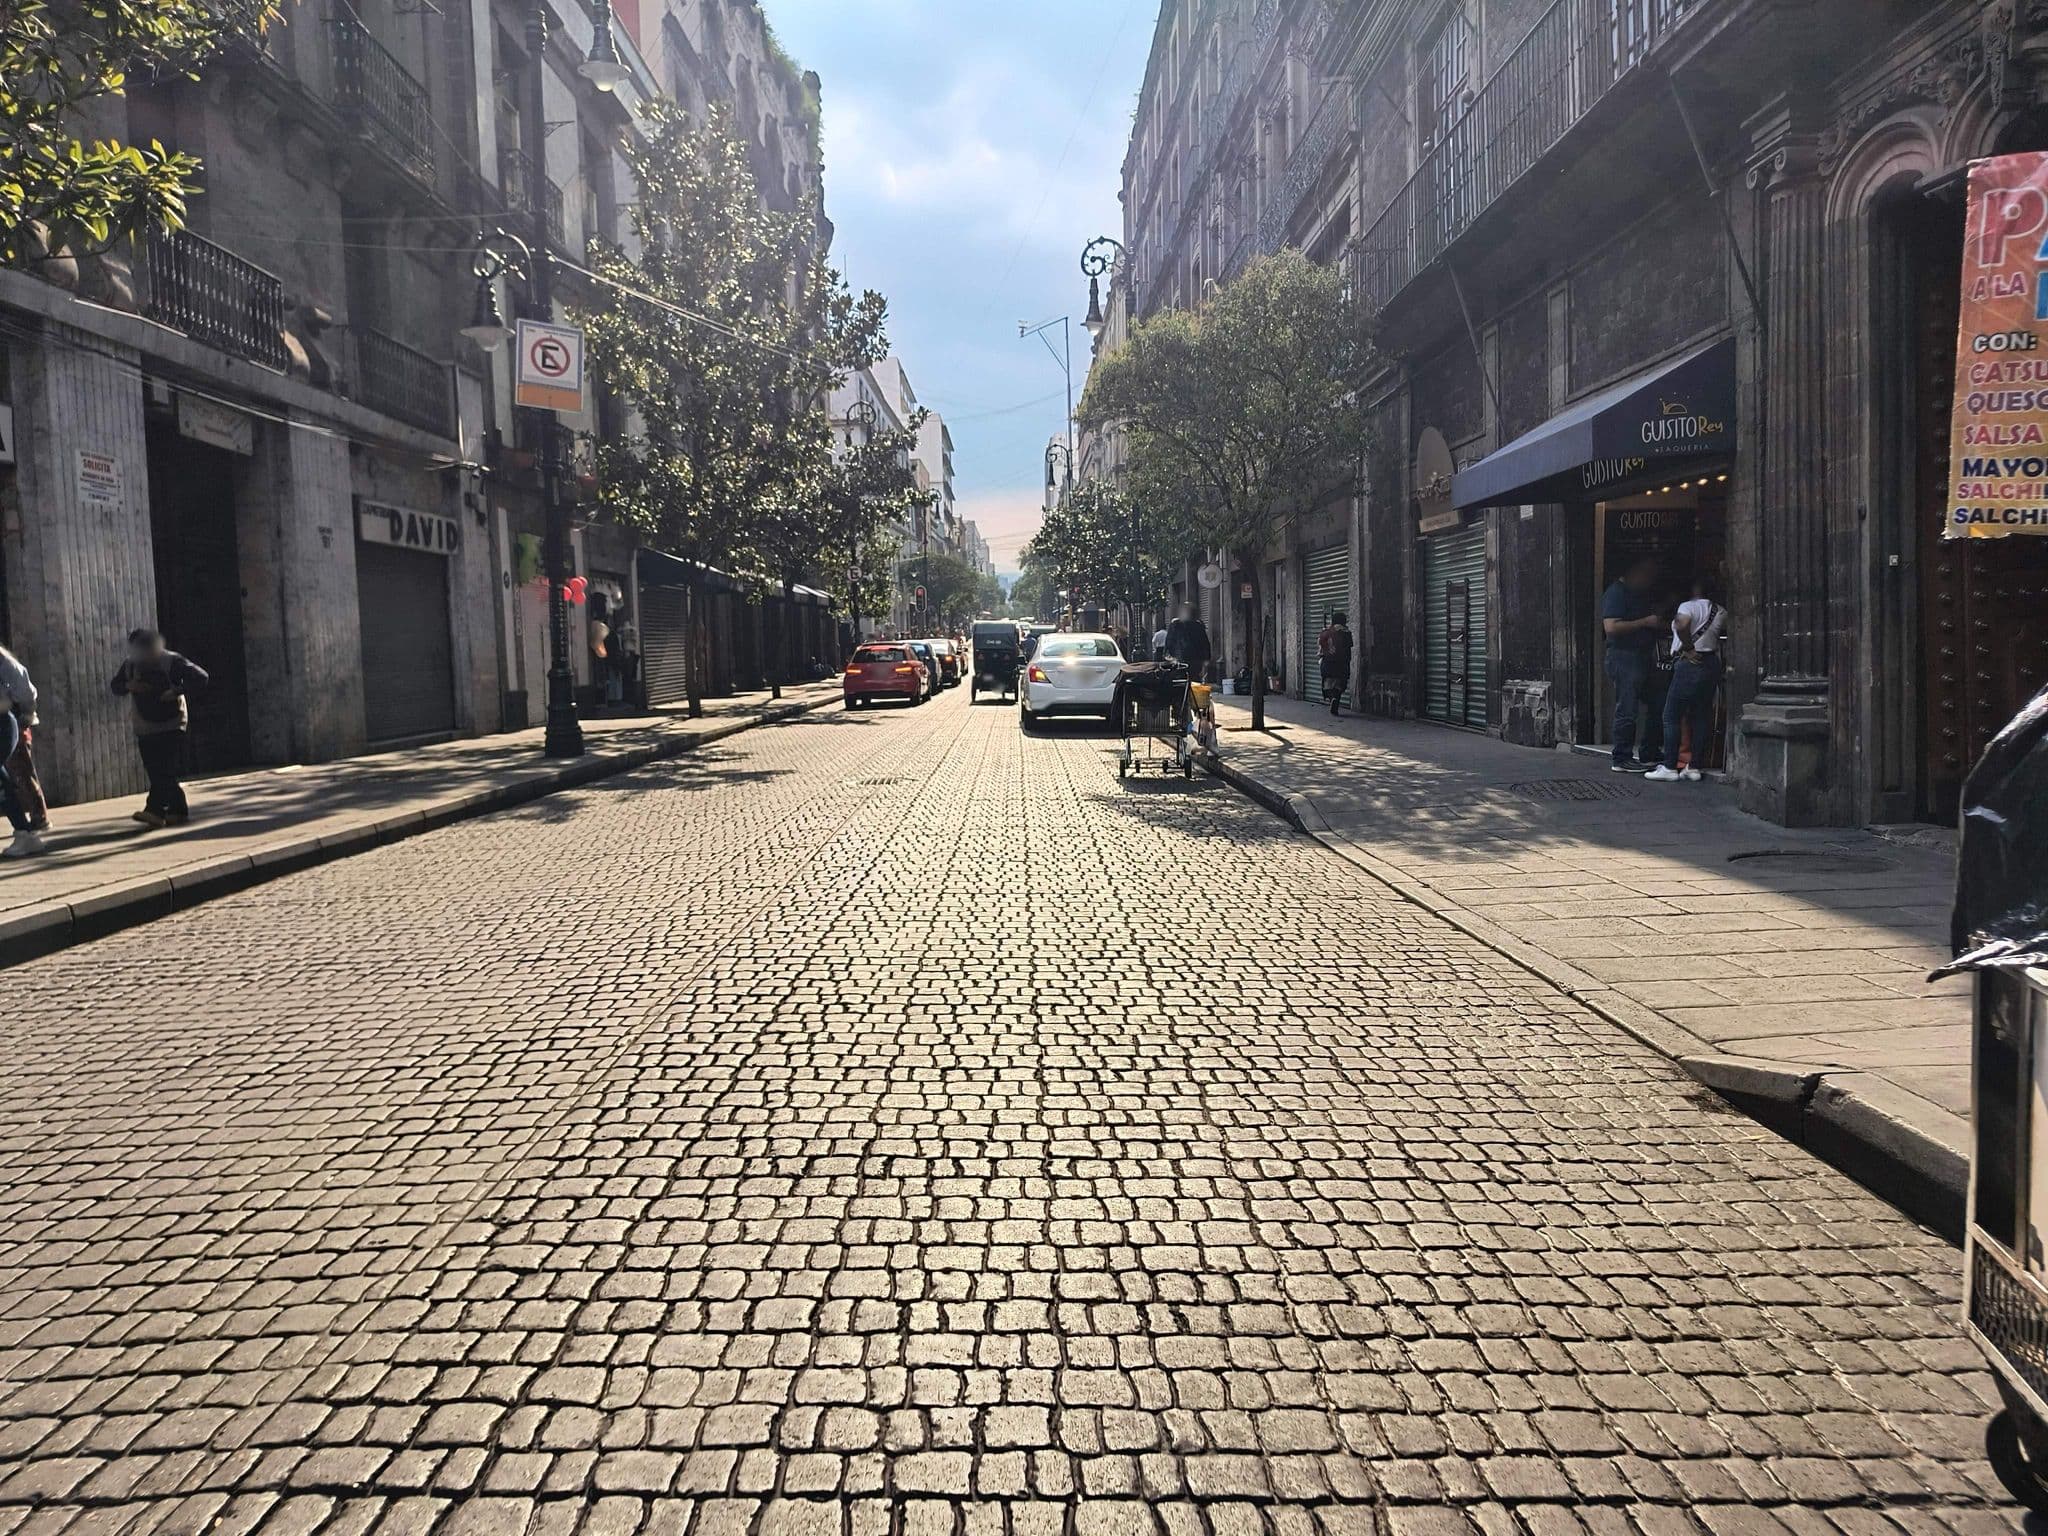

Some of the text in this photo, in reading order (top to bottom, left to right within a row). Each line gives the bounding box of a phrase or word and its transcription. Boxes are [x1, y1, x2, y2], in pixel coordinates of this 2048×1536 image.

[1971, 275, 1988, 302] A
[1993, 271, 2028, 298] LA
[1973, 333, 2038, 353] CON:
[1641, 415, 1723, 443] GUISITO Rey
[1965, 424, 2043, 445] SALSA
[1962, 457, 2048, 478] MAYO
[390, 509, 458, 552] DAVID
